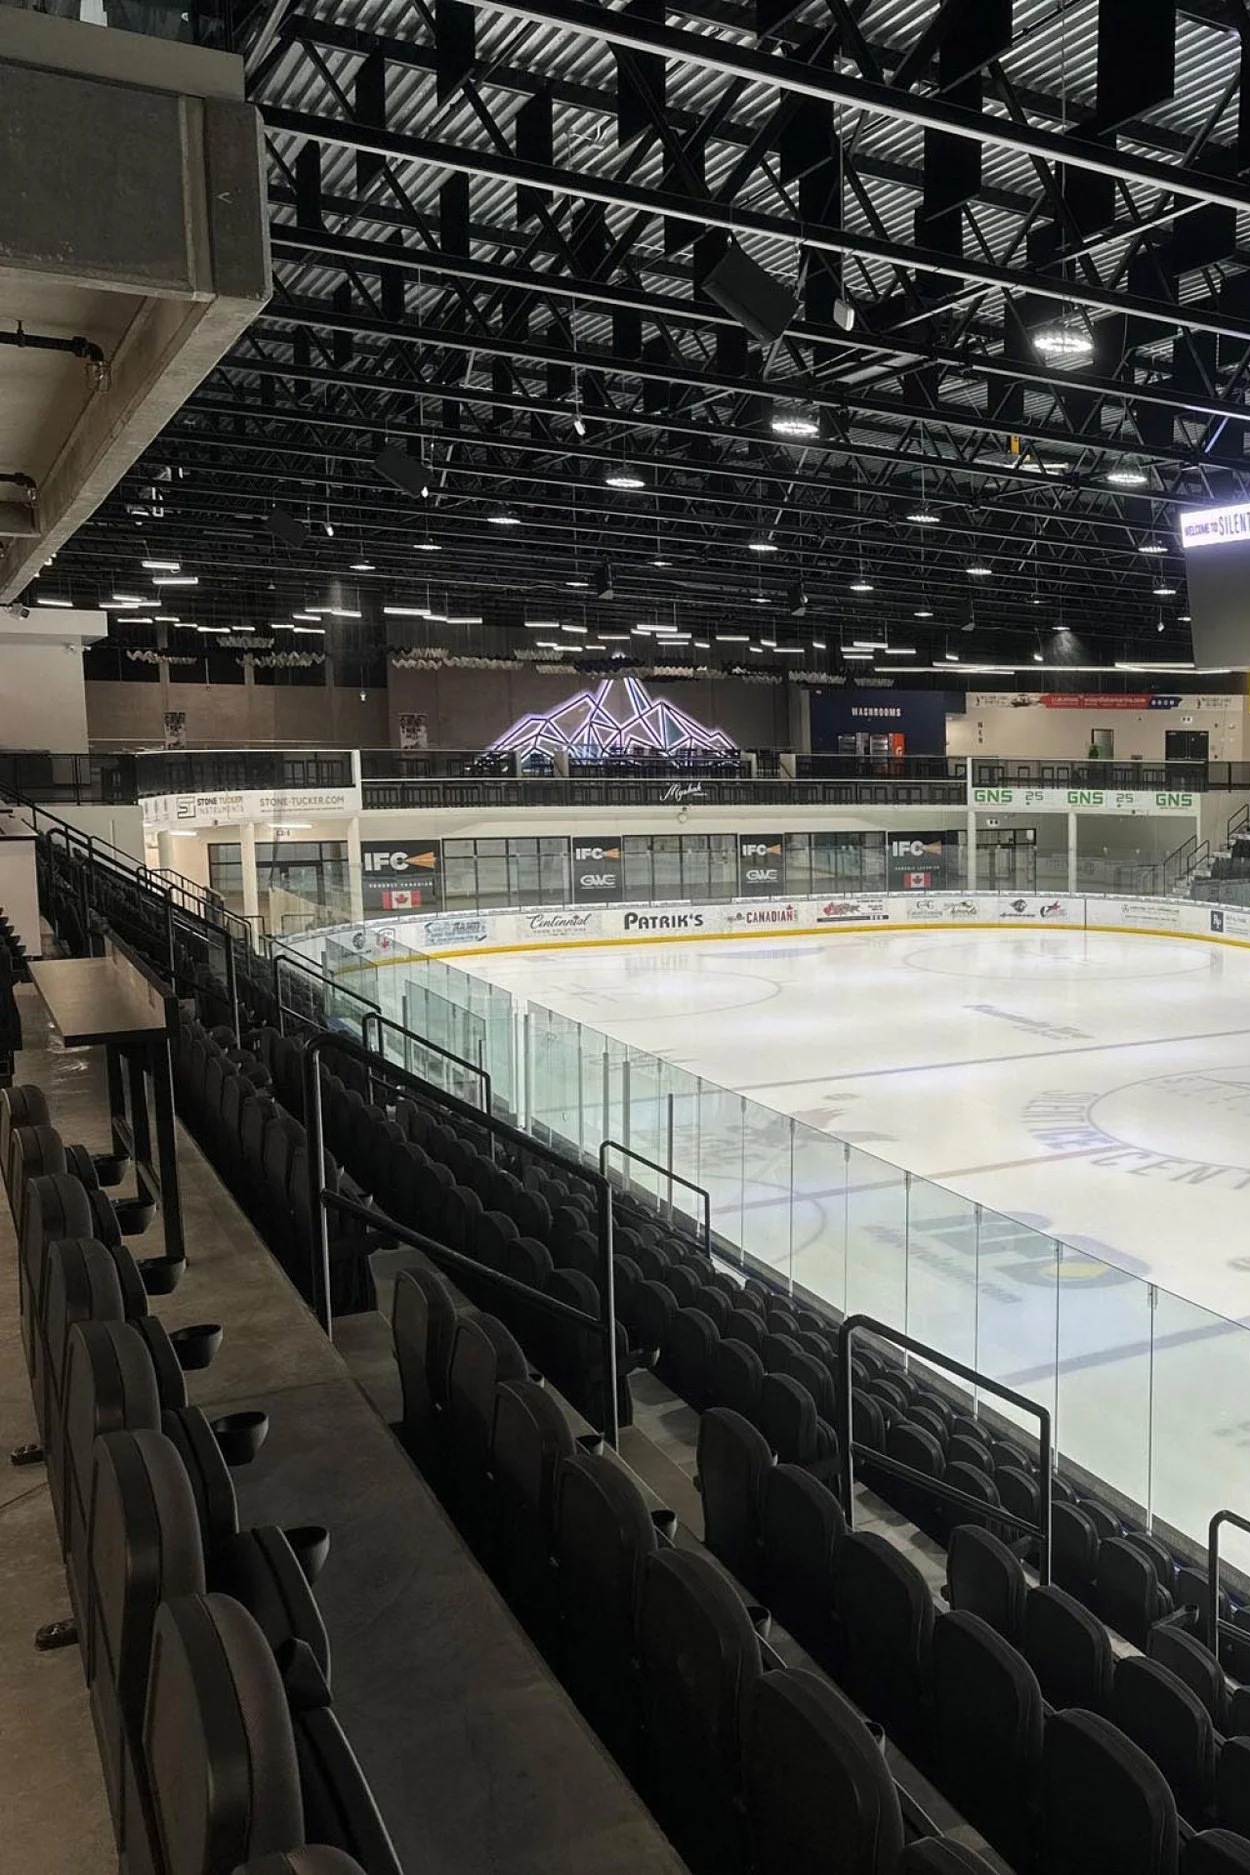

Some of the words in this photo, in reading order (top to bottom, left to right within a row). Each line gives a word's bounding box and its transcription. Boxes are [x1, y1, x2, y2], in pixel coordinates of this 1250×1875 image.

[1219, 512, 1250, 536] SILENT
[852, 707, 901, 716] WASHROOMS
[197, 798, 217, 806] STONE
[219, 796, 243, 804] TUCKER
[974, 790, 1013, 802] GNS
[1067, 791, 1104, 804] GNS
[1156, 794, 1192, 806] GNS
[576, 848, 603, 859] IFC
[742, 844, 767, 856] IFC
[892, 841, 925, 857] IFC
[365, 852, 409, 871] IFC
[526, 913, 592, 929] Centennial
[624, 912, 703, 930] PATRIK'S
[746, 910, 793, 924] CANADIAN
